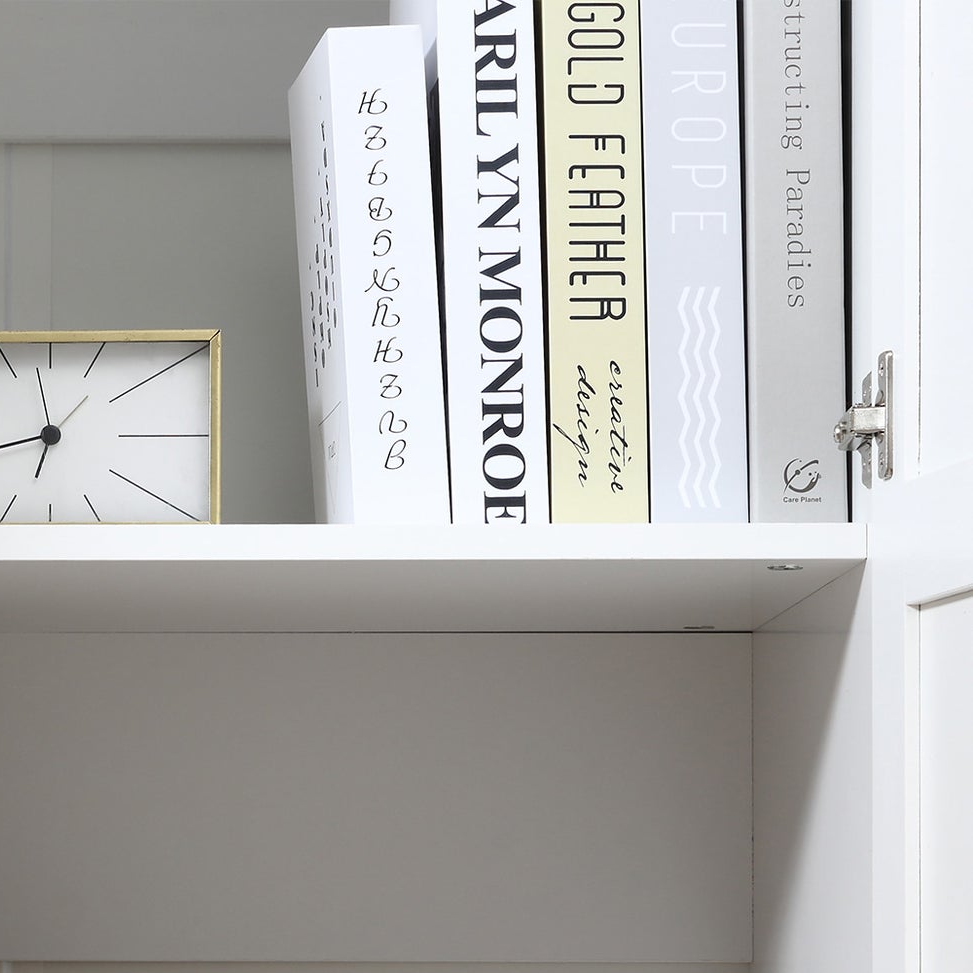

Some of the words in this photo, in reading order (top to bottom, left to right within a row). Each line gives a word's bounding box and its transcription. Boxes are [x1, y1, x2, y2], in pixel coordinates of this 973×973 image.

[567, 2, 626, 105] GOLD
[568, 134, 627, 321] FEATHER
[785, 168, 812, 308] Paradies
[479, 246, 528, 524] MONROE
[552, 364, 599, 488] design
[608, 360, 632, 494] creative
